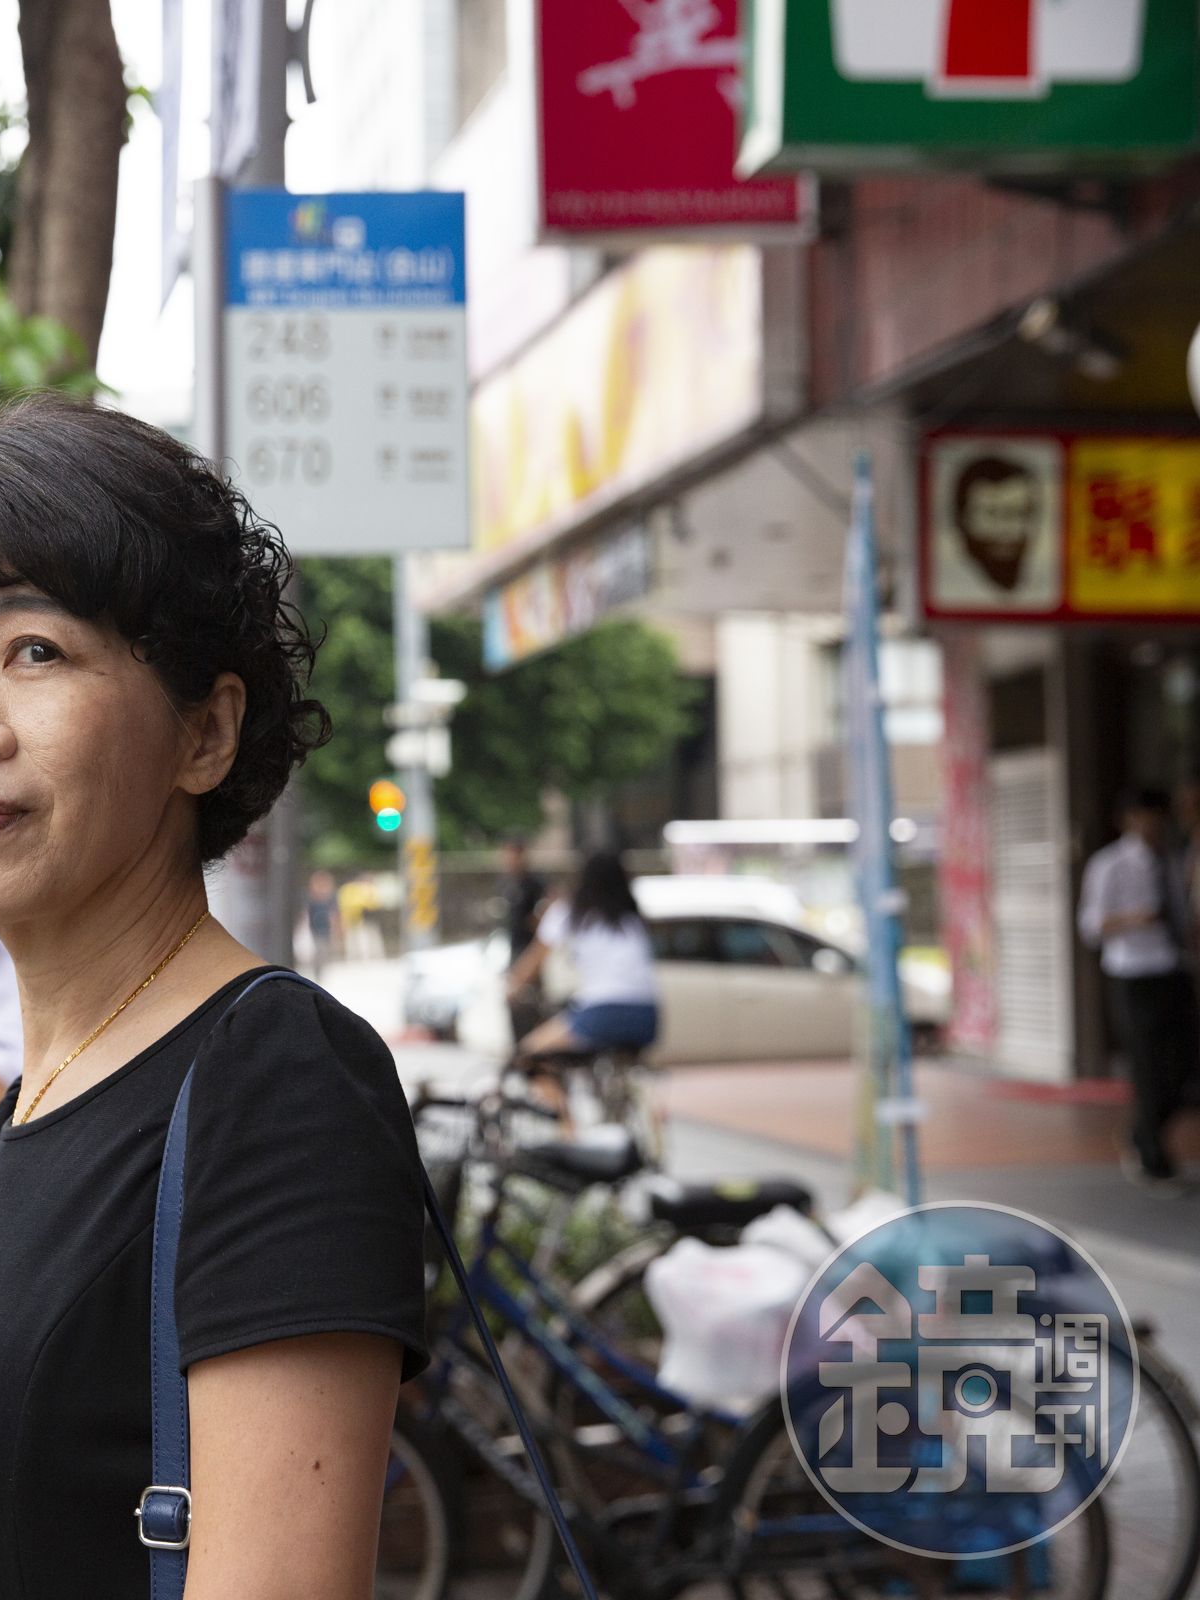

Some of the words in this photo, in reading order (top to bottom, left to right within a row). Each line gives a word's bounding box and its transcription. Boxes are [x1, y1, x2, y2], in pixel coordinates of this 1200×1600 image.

[246, 315, 331, 362] 248
[247, 374, 332, 424] 606
[247, 435, 333, 486] 670
